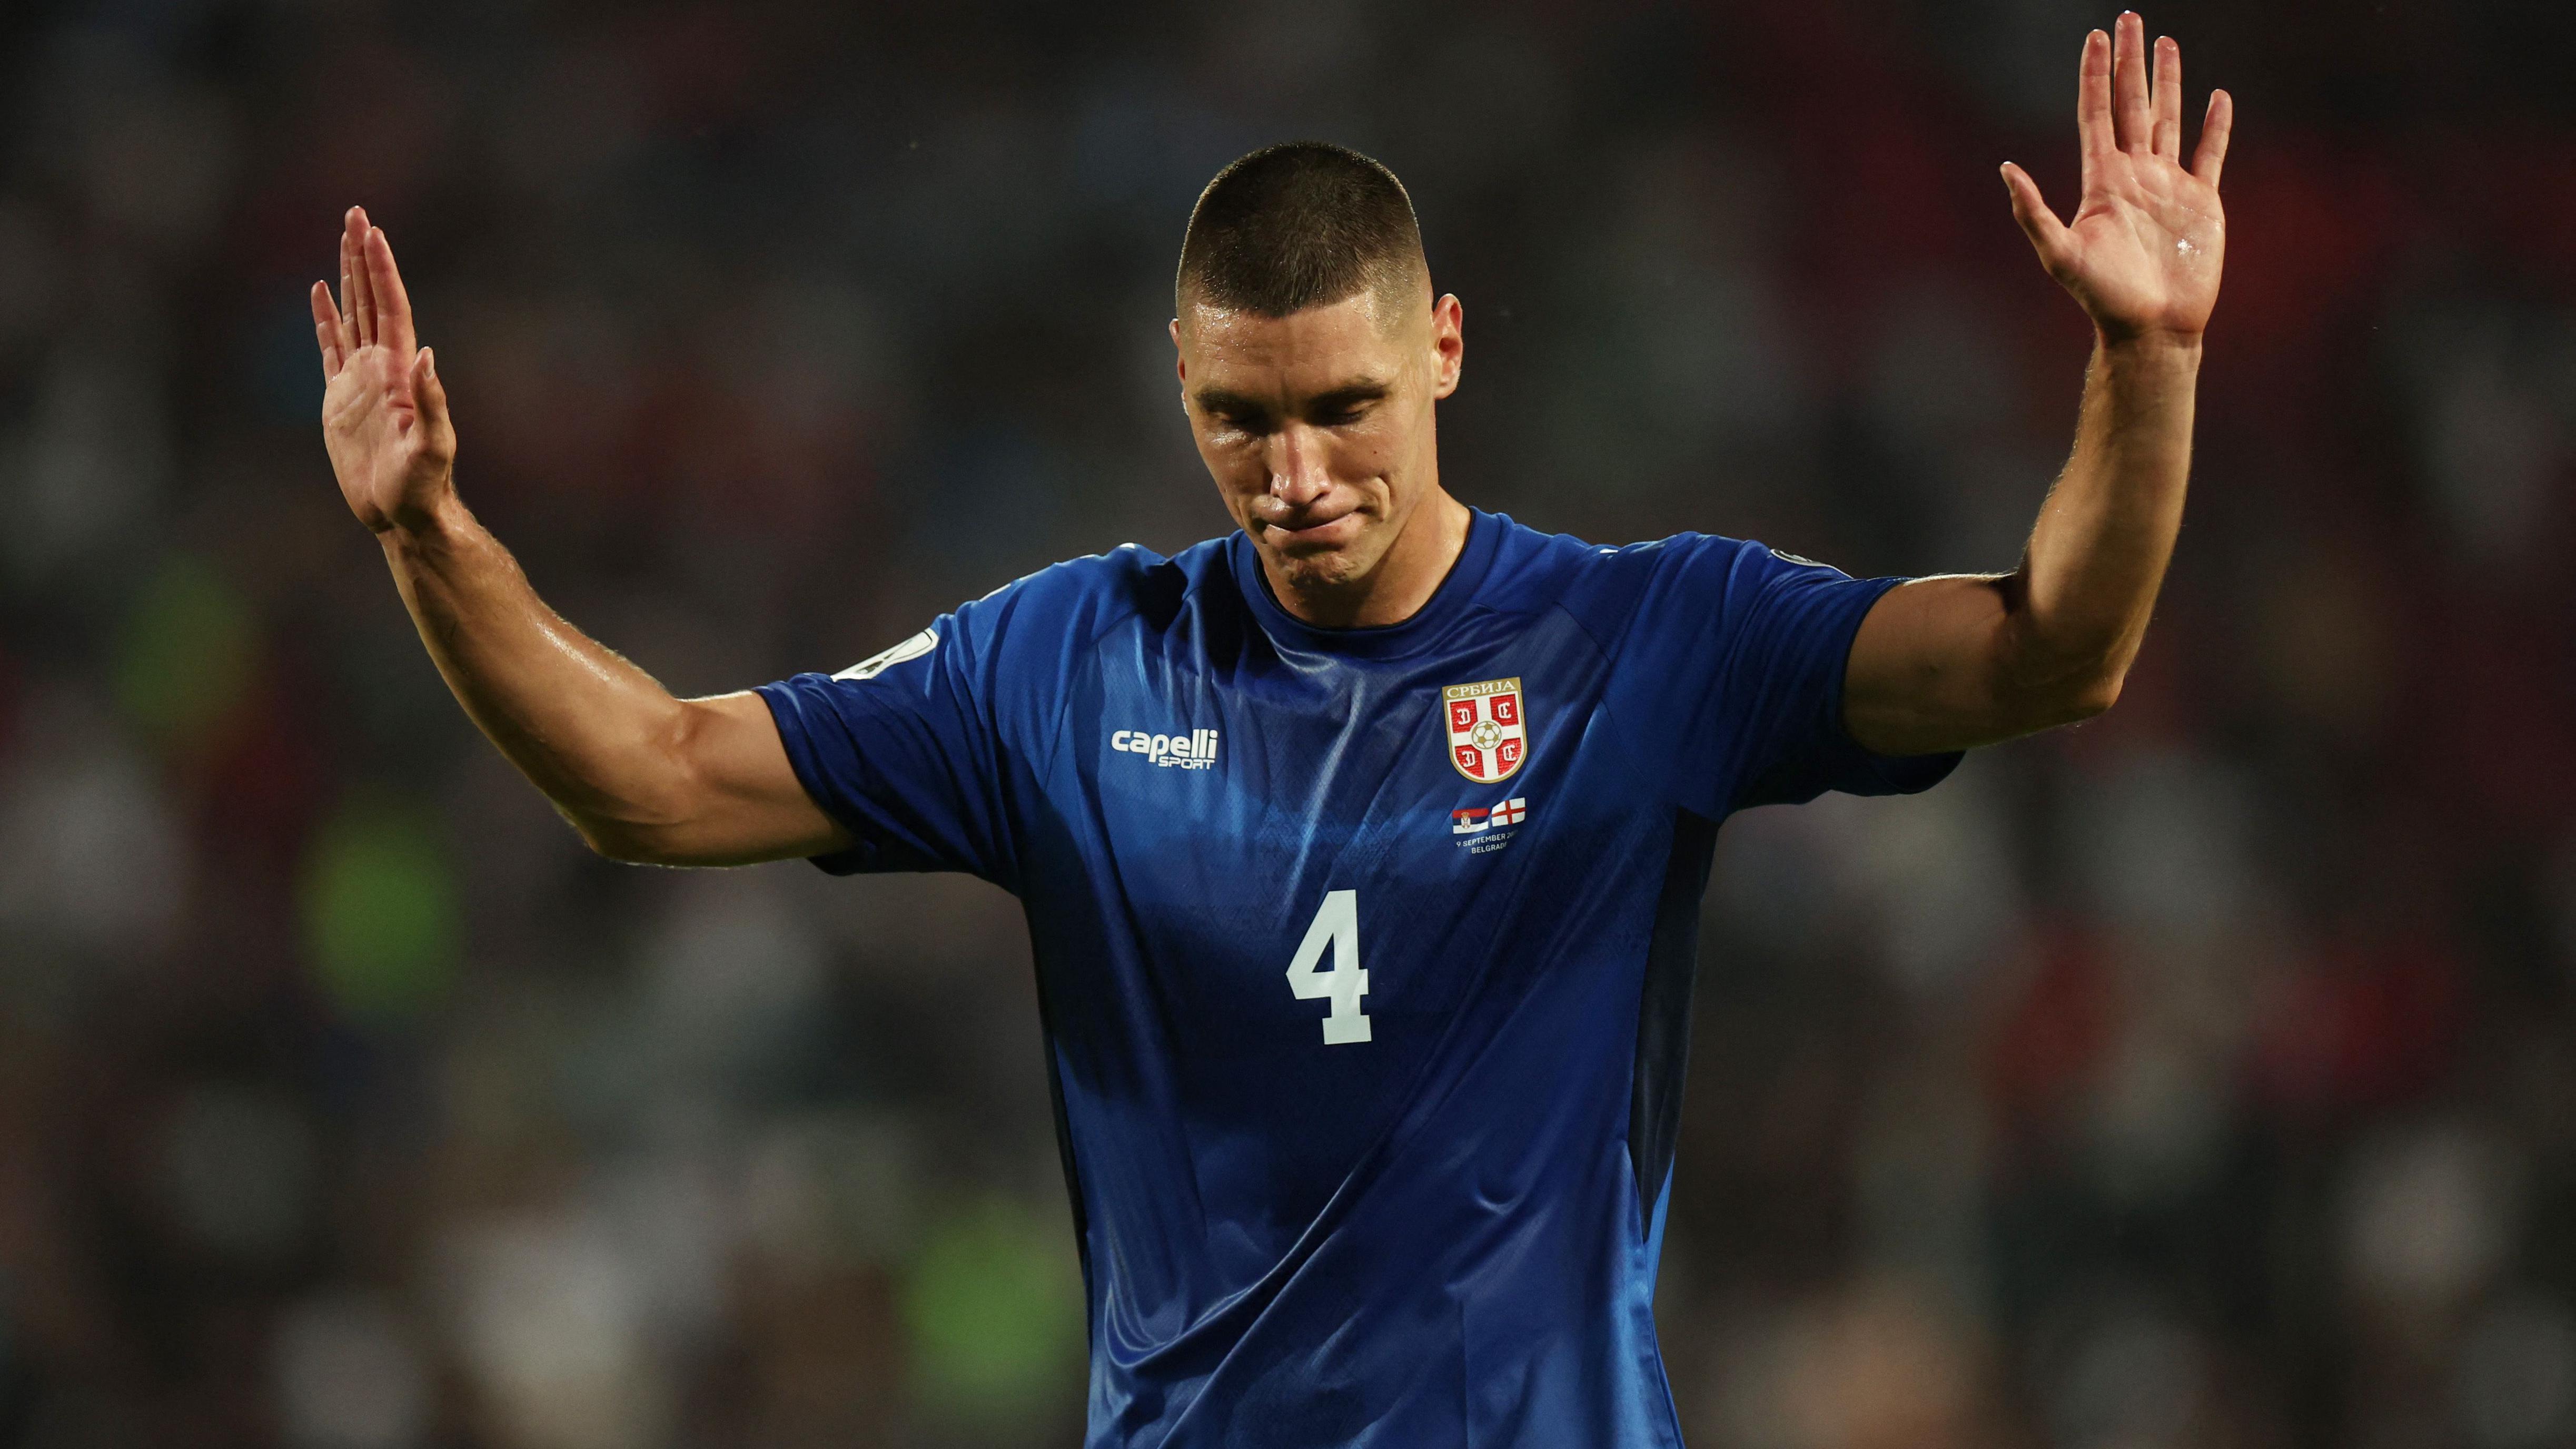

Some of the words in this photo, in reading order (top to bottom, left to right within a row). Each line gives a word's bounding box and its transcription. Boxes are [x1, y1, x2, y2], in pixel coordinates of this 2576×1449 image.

[1447, 681, 1515, 698] СРБИЈА
[1112, 729, 1218, 763] capelli
[1158, 757, 1215, 770] SPORT
[1463, 834, 1505, 846] SEPTEMBER
[1286, 889, 1372, 1045] 4
